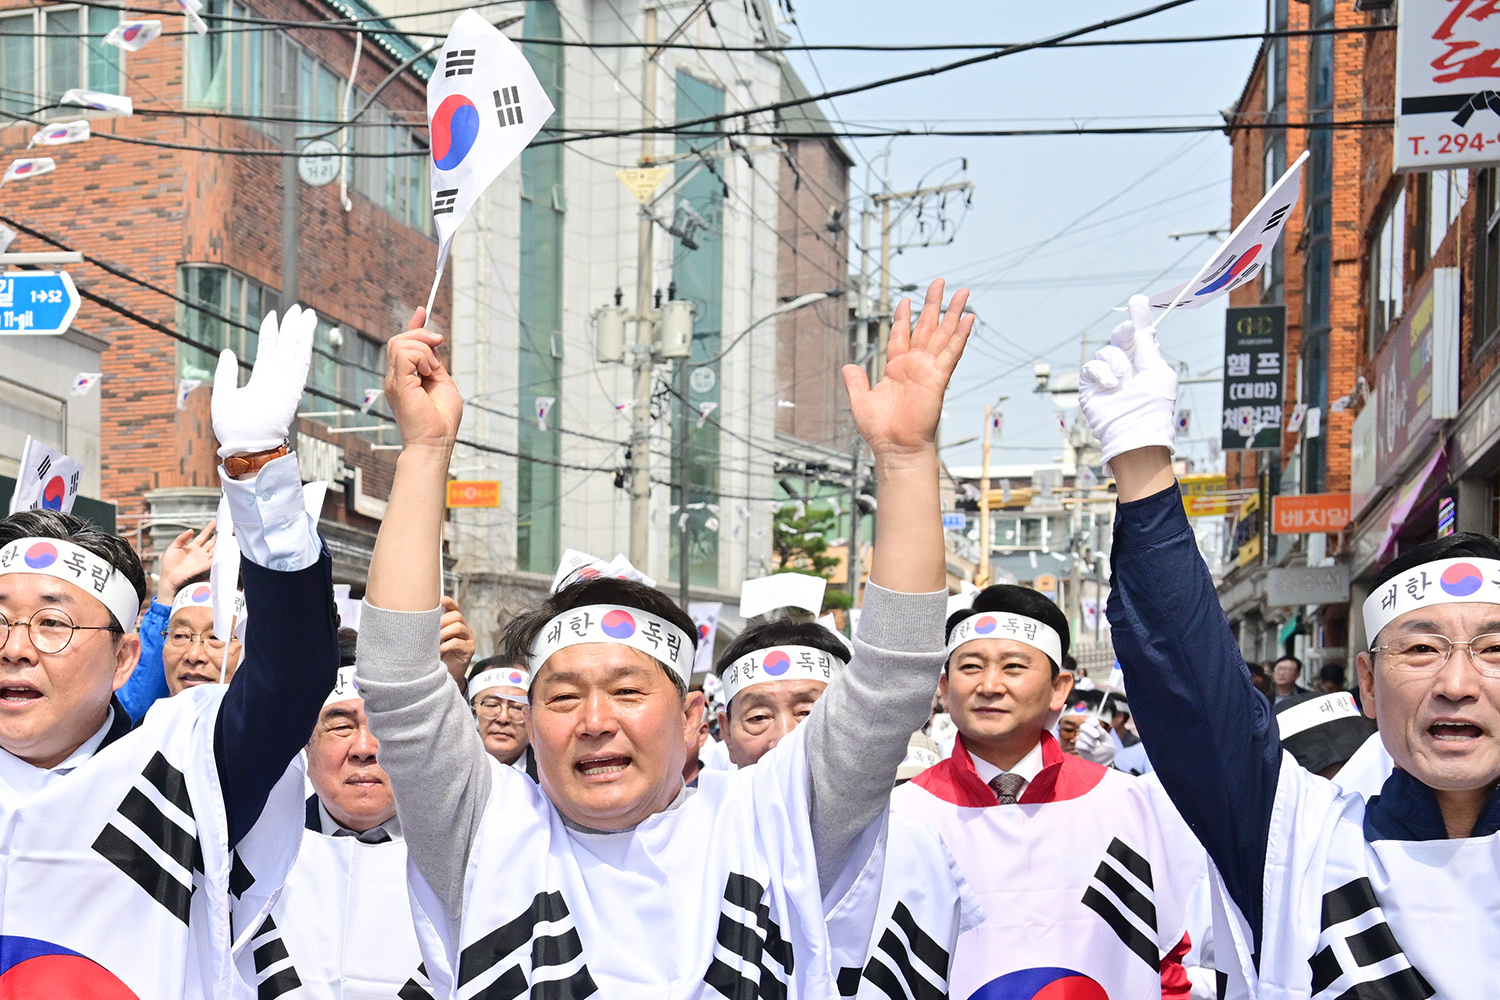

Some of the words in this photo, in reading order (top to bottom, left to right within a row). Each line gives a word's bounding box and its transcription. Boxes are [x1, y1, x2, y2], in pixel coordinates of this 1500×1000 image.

[1408, 136, 1429, 156] T.
[1438, 133, 1500, 154] 294-
[3, 310, 33, 330] 11-gil
[1281, 507, 1349, 528] 베지밀
[63, 551, 111, 593] 독립
[1381, 571, 1432, 611] 대한
[547, 612, 594, 645] 대한
[642, 620, 682, 663] 독립
[1002, 618, 1037, 640] 독립
[730, 657, 758, 685] 대한
[796, 652, 831, 679] 독립
[1319, 696, 1349, 714] 대한
